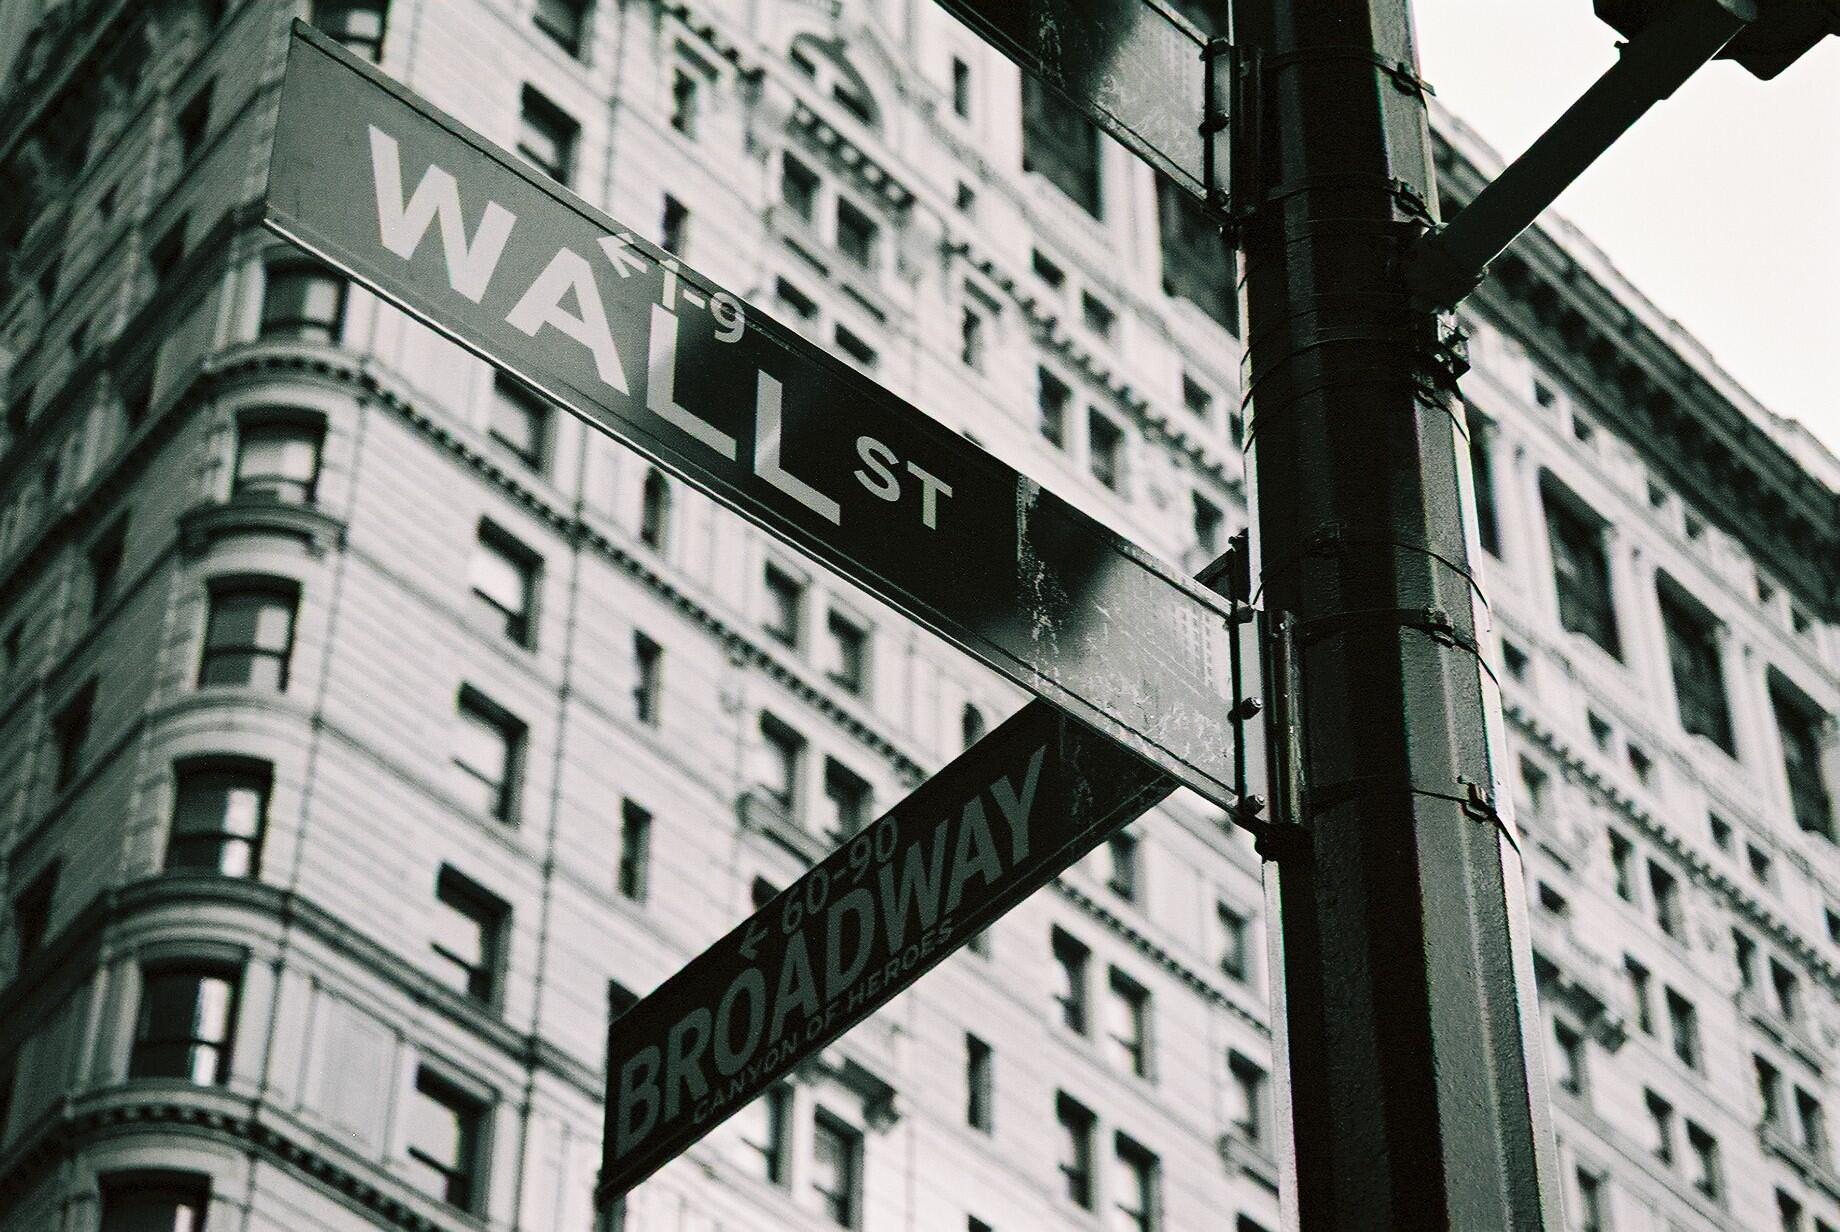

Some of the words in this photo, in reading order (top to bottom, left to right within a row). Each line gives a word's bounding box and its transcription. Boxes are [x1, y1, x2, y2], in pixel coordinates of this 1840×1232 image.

[367, 123, 842, 528] WALL
[852, 434, 953, 531] ST
[659, 258, 745, 344] 1-9
[615, 744, 1046, 1160] BROADWAY
[782, 816, 899, 935] 60-90
[692, 1031, 799, 1124] CANYON
[807, 1000, 839, 1043] OF
[847, 917, 955, 1011] HEROES
